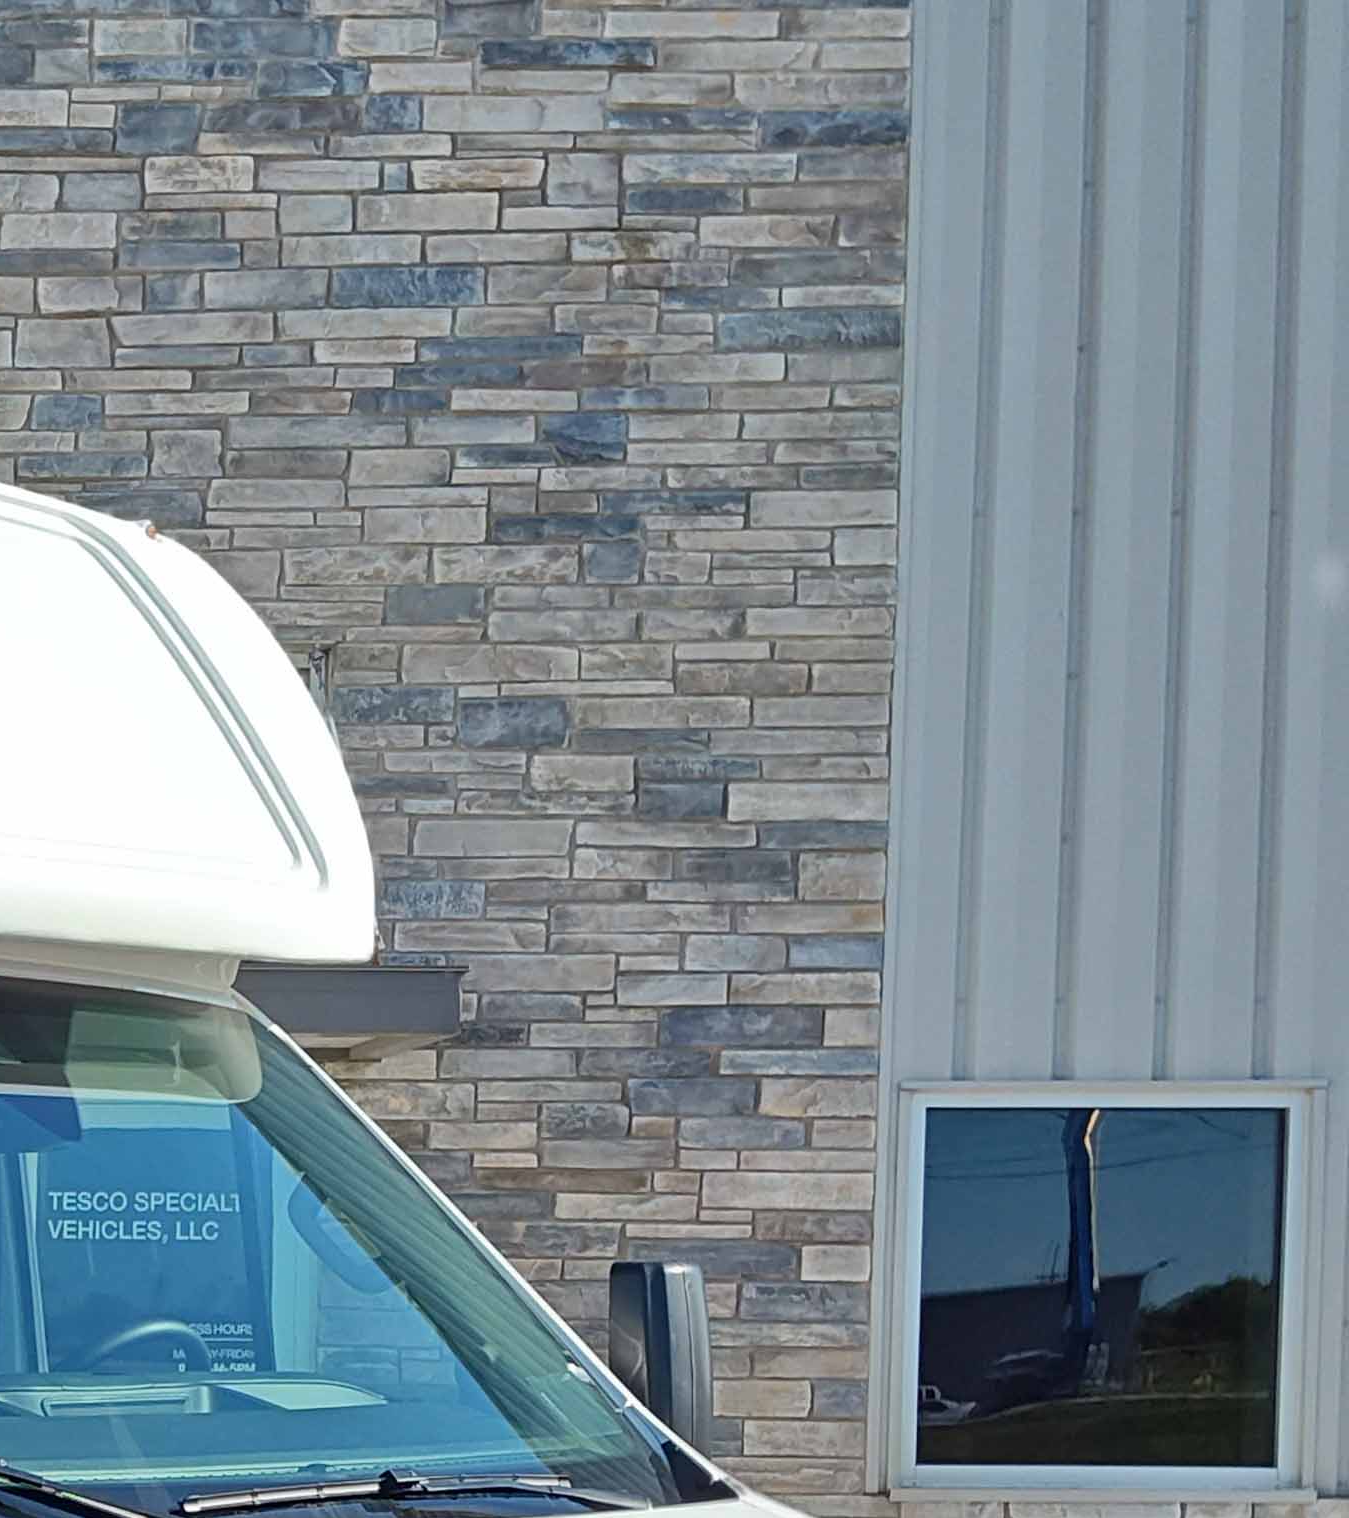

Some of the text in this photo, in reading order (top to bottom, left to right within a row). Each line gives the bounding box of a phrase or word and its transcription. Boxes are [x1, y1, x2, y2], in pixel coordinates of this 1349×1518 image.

[48, 1192, 127, 1212] TESCO
[47, 1220, 219, 1244] VEHICLES, LLC
